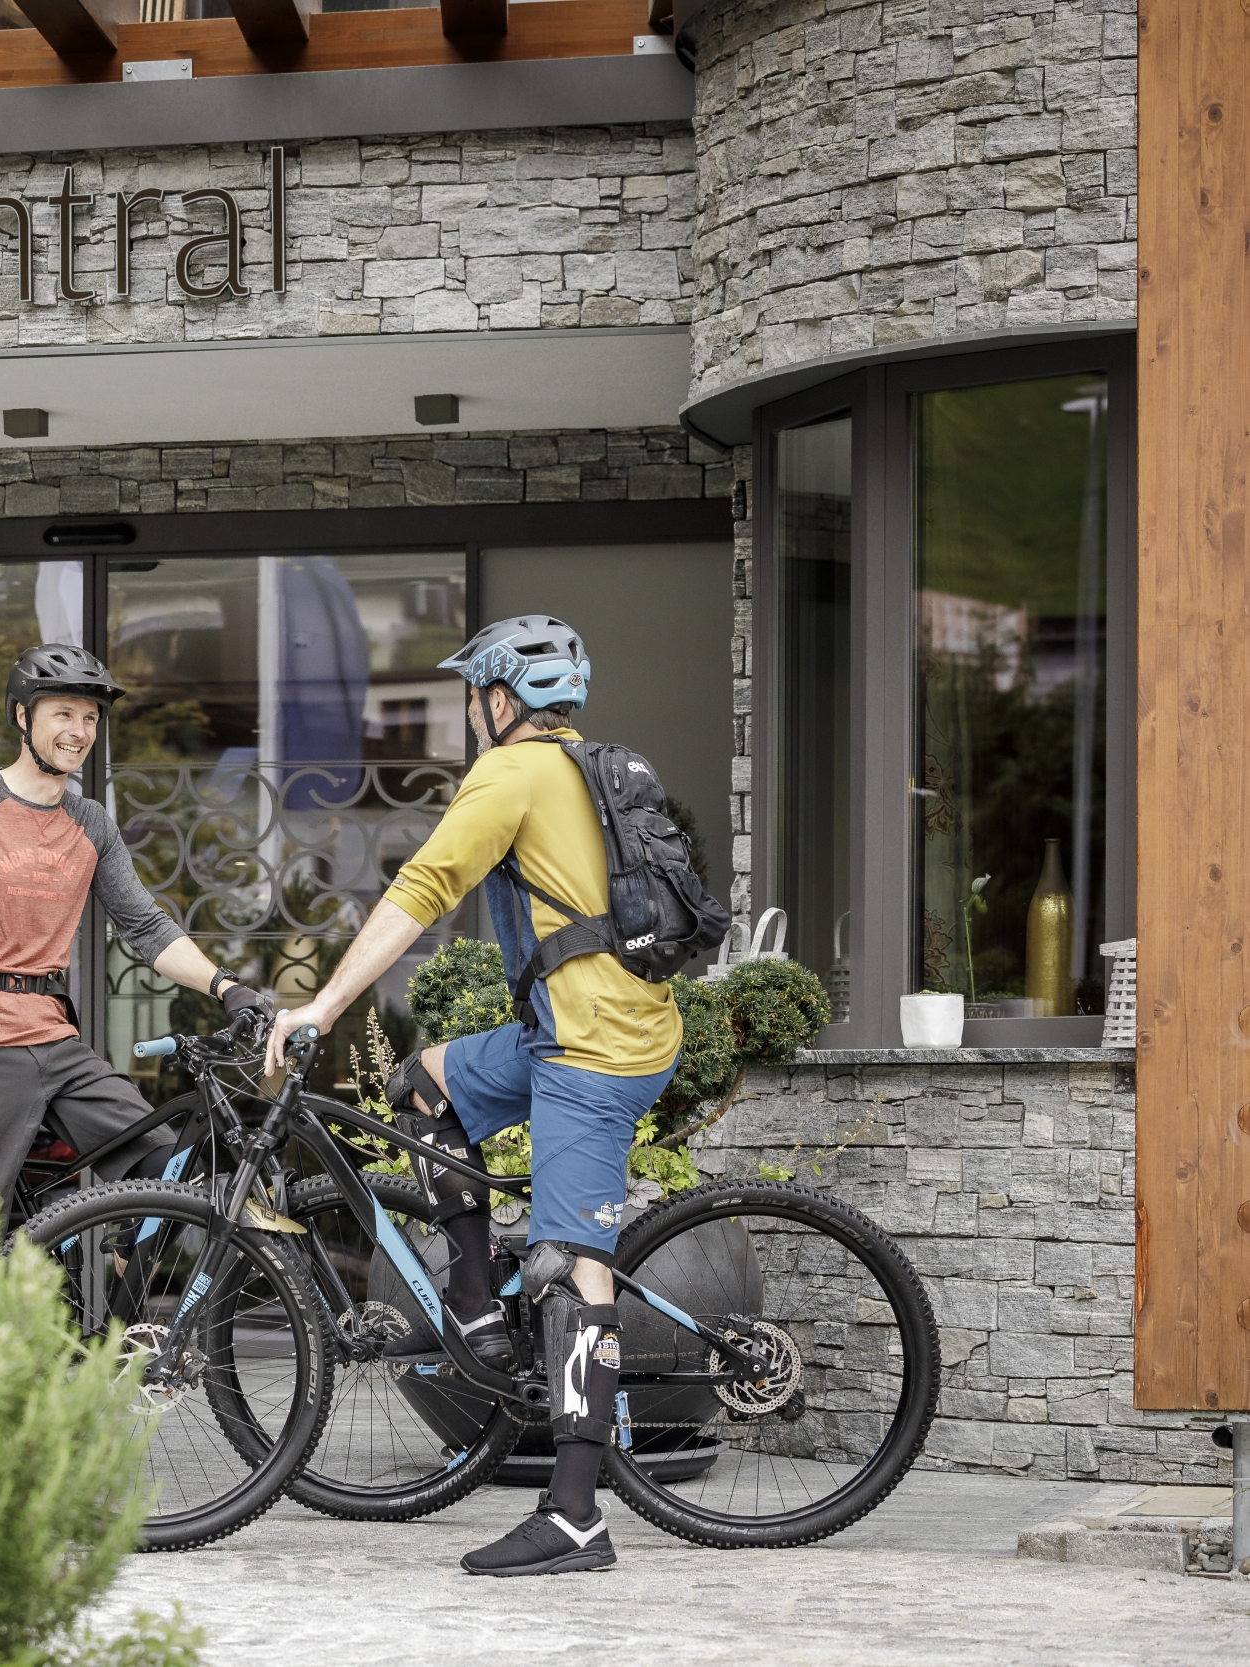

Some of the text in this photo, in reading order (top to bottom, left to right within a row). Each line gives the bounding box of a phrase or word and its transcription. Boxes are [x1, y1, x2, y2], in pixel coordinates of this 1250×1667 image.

[36, 846, 77, 881] ROYALE
[626, 933, 654, 950] evoc
[169, 1157, 183, 1183] UBE
[797, 1205, 873, 1250] NOBBY
[412, 1280, 439, 1316] CUBE
[283, 1275, 318, 1405] NOBBY NIC
[388, 1443, 490, 1507] SCHWALBE
